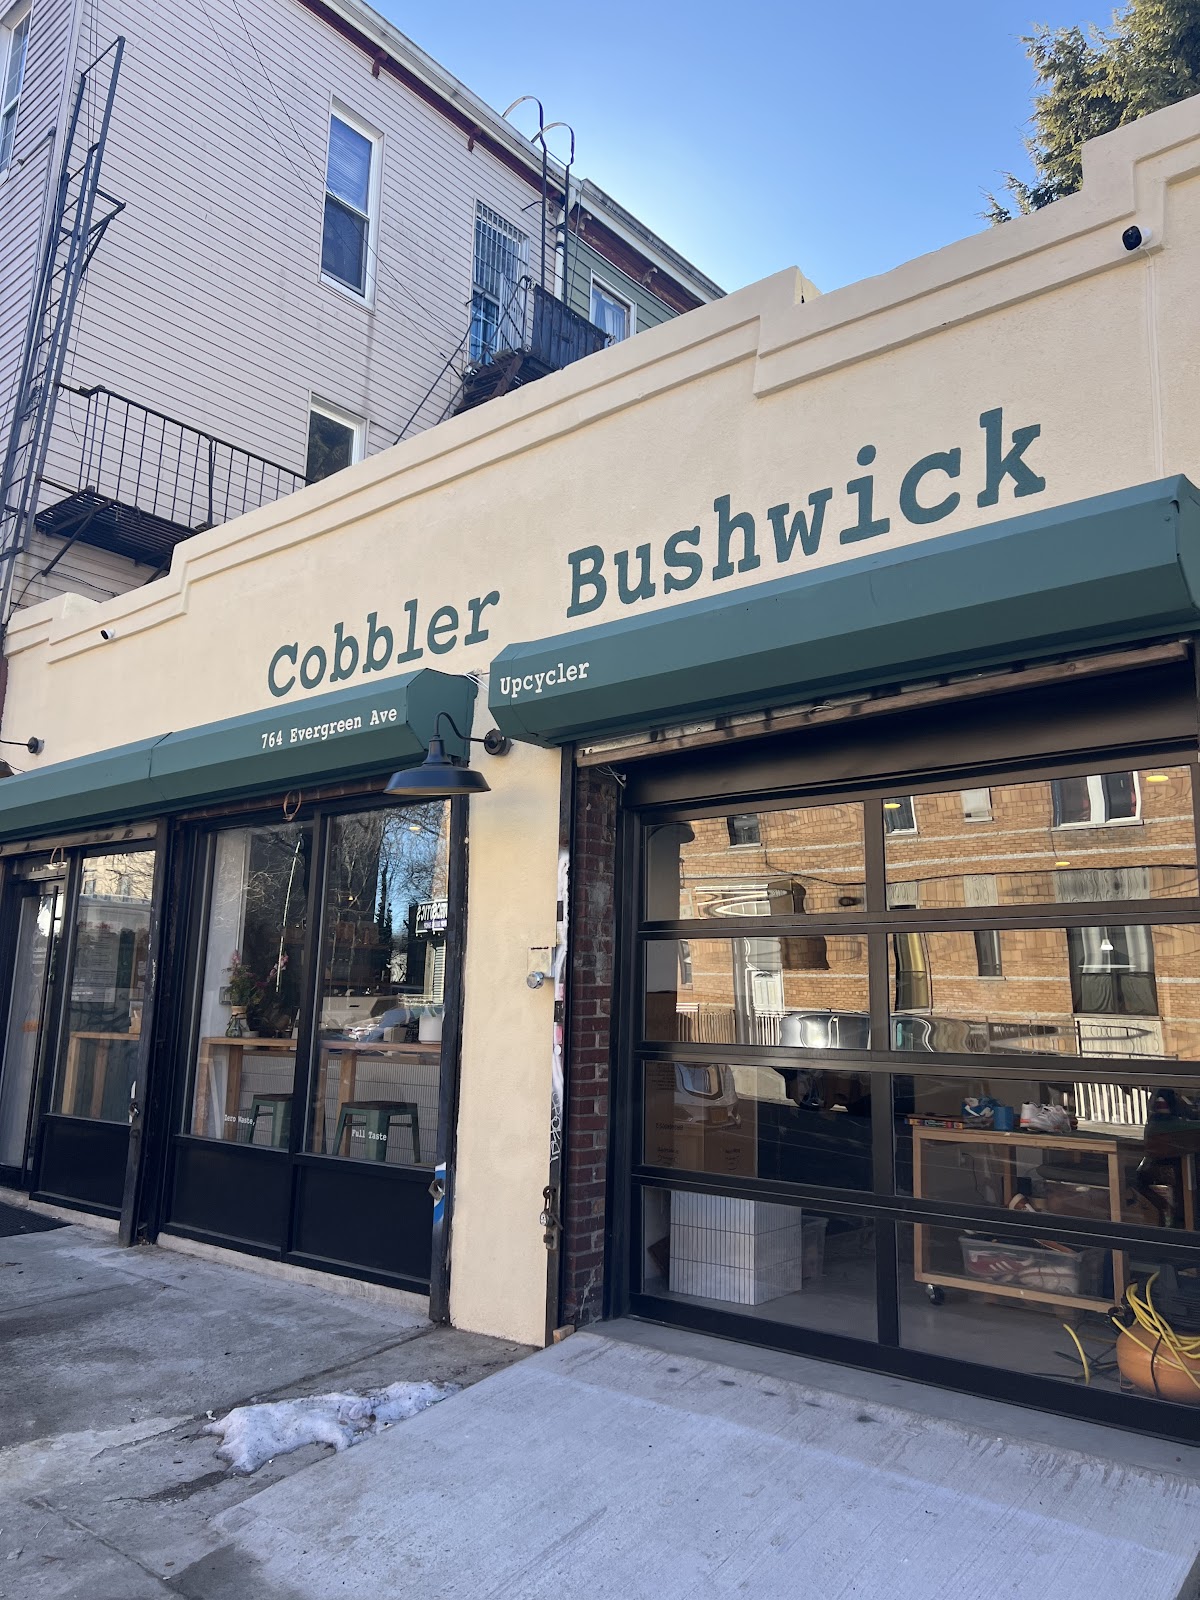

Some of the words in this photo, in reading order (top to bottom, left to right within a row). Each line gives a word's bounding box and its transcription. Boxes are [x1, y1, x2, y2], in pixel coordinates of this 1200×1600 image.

[267, 590, 500, 698] Cobbler
[566, 407, 1046, 618] Bushwick
[499, 662, 590, 698] Upcycler
[261, 730, 283, 749] 764
[289, 716, 362, 741] Evergreen
[369, 708, 398, 726] Ave
[351, 1129, 366, 1138] Full
[368, 1131, 387, 1141] Taste
